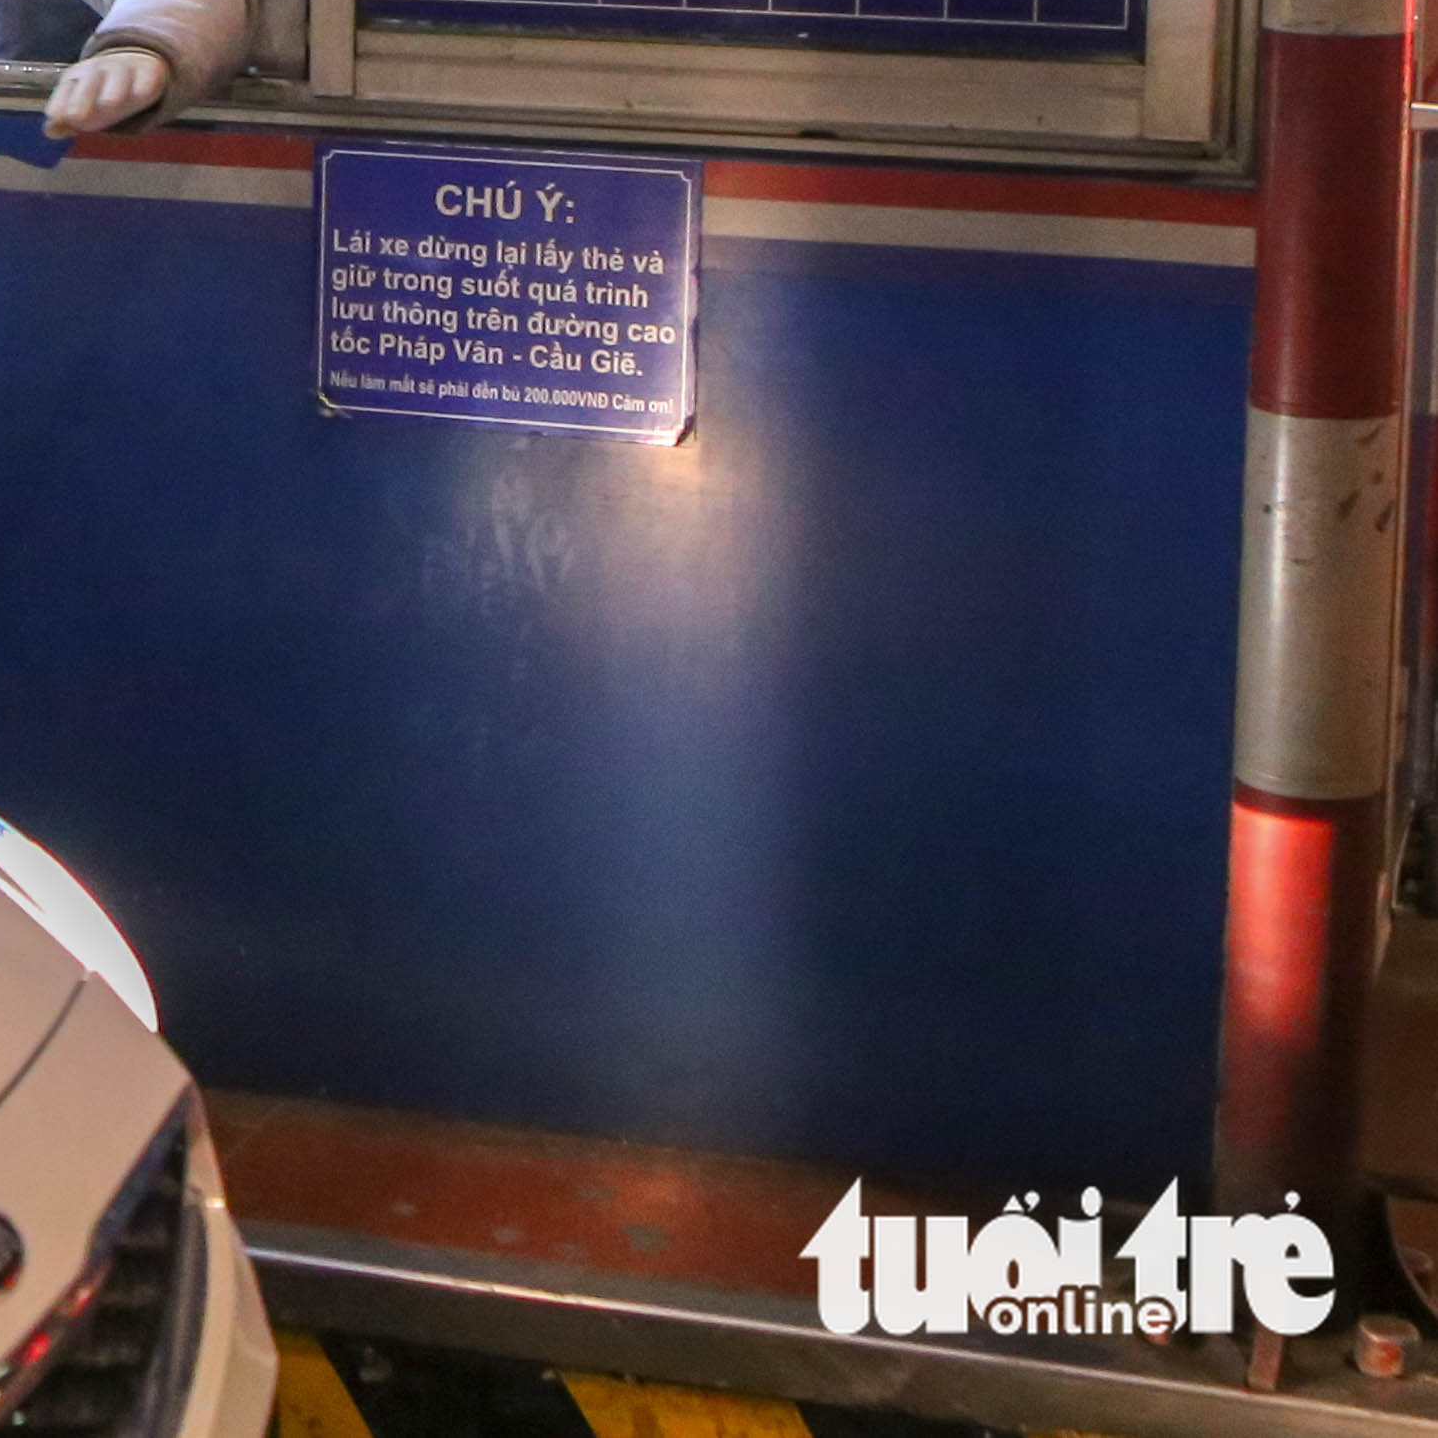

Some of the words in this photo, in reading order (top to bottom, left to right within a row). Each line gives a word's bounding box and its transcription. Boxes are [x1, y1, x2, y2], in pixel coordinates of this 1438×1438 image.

[435, 181, 521, 220] CHÚ
[535, 182, 575, 224] Ý:
[333, 229, 371, 254] Lái
[379, 236, 409, 256] xe
[417, 234, 487, 265] dừng
[497, 241, 526, 270] lại
[536, 243, 574, 273] lấy
[582, 246, 624, 272] thẻ
[633, 250, 665, 275] và
[332, 265, 376, 292] giữ
[383, 267, 453, 299] trong
[461, 265, 520, 299] suốt
[528, 277, 577, 306] quá
[332, 297, 374, 321] lưu
[382, 301, 458, 333] thông
[466, 307, 518, 333] trên
[527, 311, 618, 346] đường
[627, 322, 676, 345] cao
[330, 327, 370, 354] tốc
[379, 334, 446, 365] Pháp
[452, 338, 503, 365] Vân
[529, 343, 582, 372] Cầu
